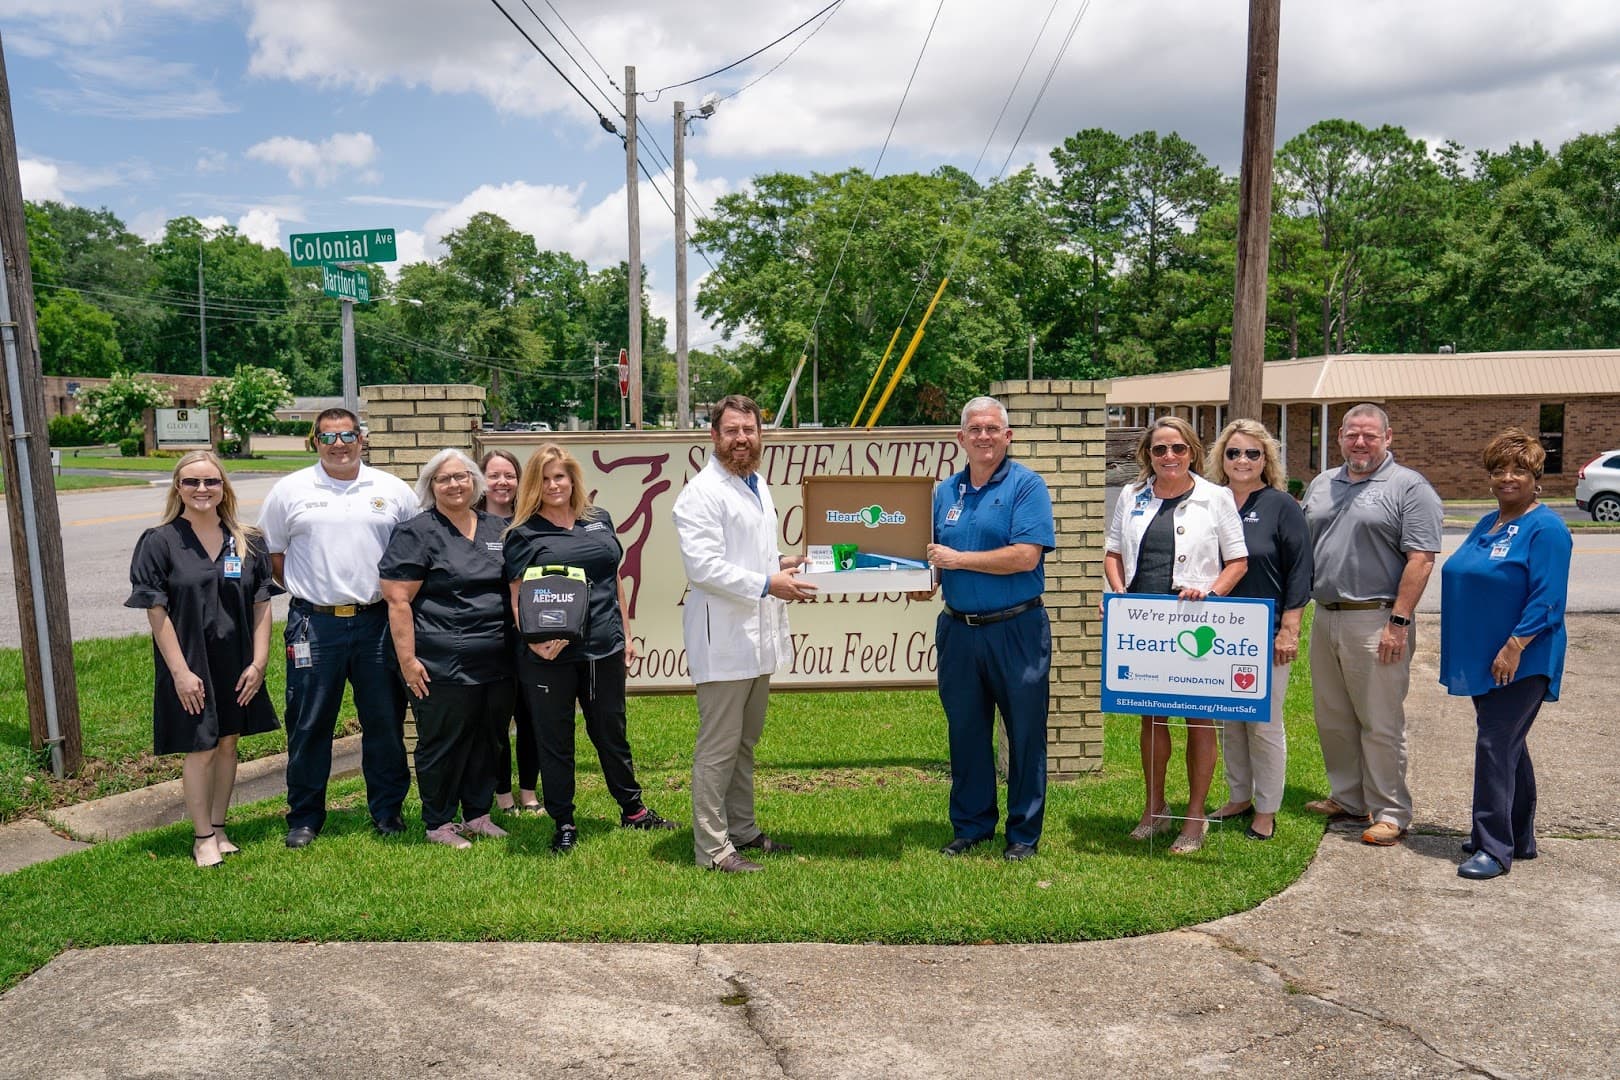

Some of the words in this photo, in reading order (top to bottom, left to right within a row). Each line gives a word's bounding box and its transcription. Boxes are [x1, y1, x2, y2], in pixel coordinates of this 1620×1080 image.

[293, 234, 368, 260] Colonial
[375, 232, 392, 245] Ave
[323, 266, 356, 296] Hartford
[178, 411, 187, 420] G
[167, 422, 199, 430] GLOVER
[683, 441, 968, 486] STHEASTER
[828, 511, 860, 522] Heart
[880, 511, 905, 523] Safe
[1127, 608, 1165, 621] We're
[1168, 611, 1208, 624] proud
[1212, 613, 1225, 624] to
[1229, 612, 1245, 625] be
[790, 633, 833, 674] You
[841, 632, 895, 673] Feel
[906, 631, 944, 673] Go
[1117, 633, 1177, 653] Heart
[1212, 638, 1259, 657] Safe
[1168, 675, 1225, 685] FOUNDATION
[1116, 698, 1257, 714] SEHealthFoundation.org/HeartSafe
